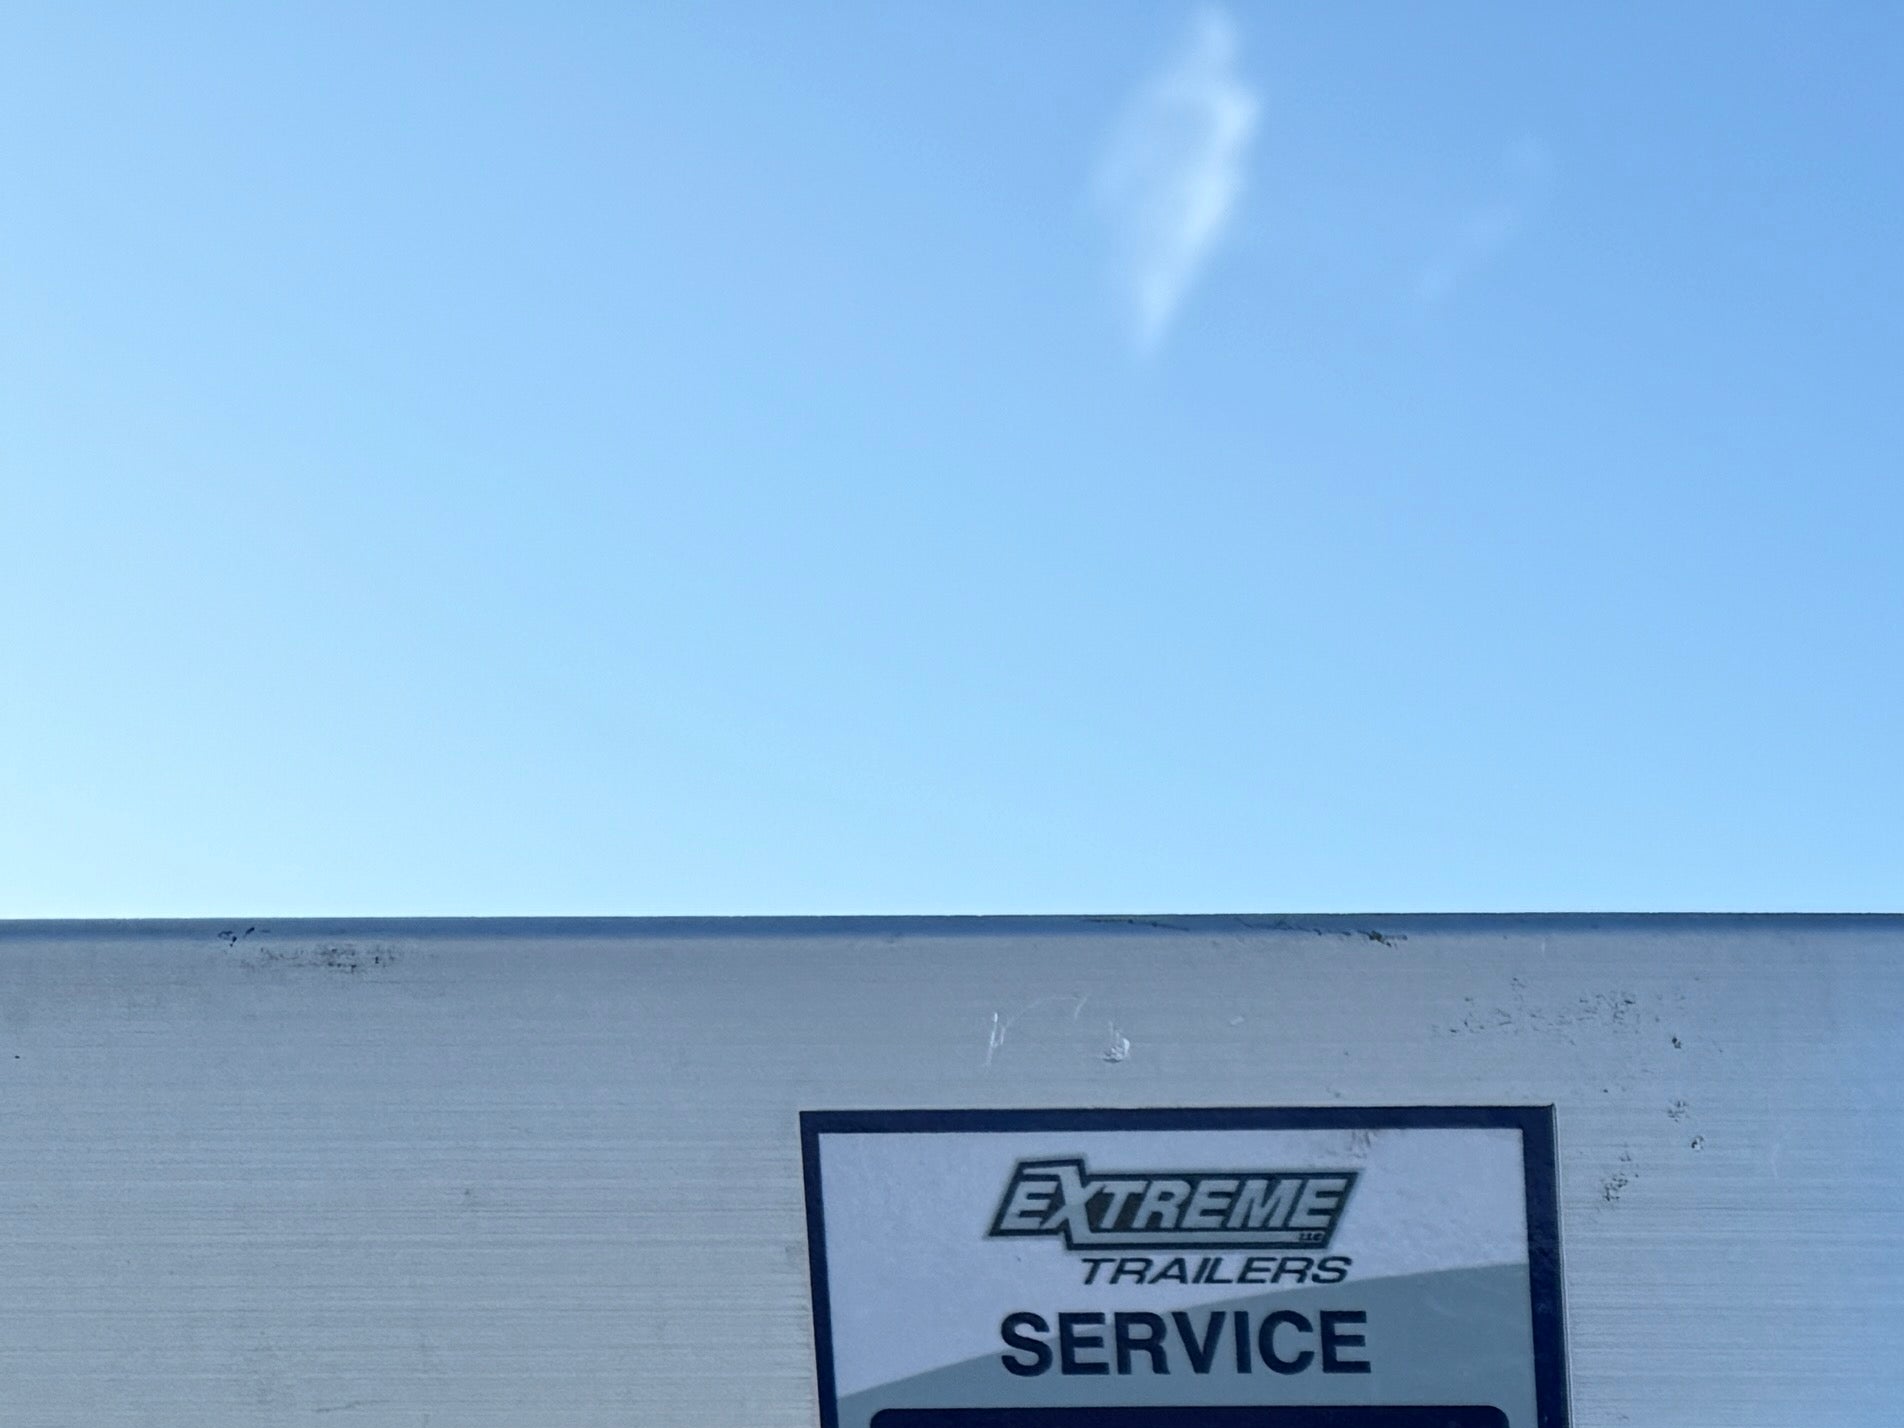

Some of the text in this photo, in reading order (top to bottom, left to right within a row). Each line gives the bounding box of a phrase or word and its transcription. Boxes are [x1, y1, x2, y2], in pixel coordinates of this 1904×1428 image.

[998, 1165, 1352, 1244] EXTREME
[1080, 1255, 1353, 1286] TRAILERS
[1000, 1310, 1372, 1376] SERVICE
